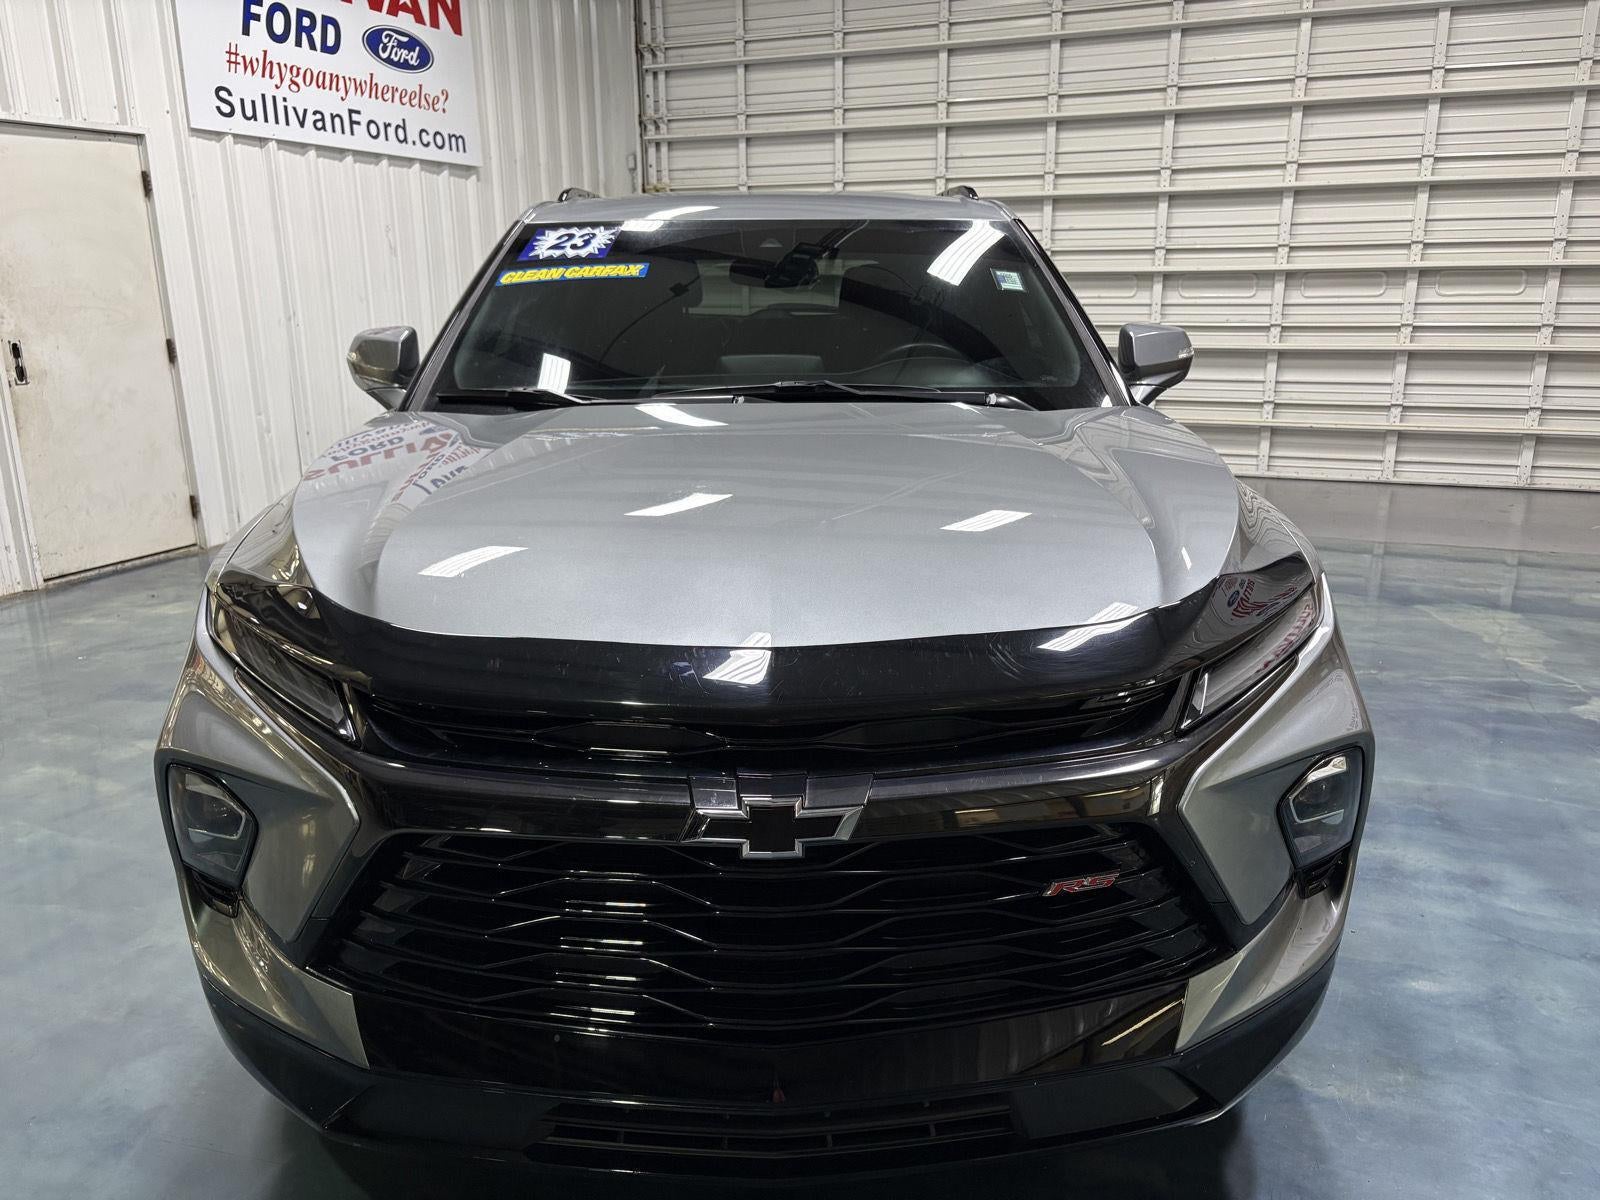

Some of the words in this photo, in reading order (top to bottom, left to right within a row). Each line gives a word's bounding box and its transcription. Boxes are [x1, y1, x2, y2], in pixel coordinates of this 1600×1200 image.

[241, 0, 341, 55] FORD
[379, 30, 420, 66] Ford
[226, 42, 449, 114] #whygoanywhereelse?
[215, 85, 467, 153] SullivanFord.com
[547, 232, 597, 250] 23
[500, 268, 565, 284] CLEAN
[564, 264, 644, 279] CARFAX
[1042, 872, 1119, 896] RS
